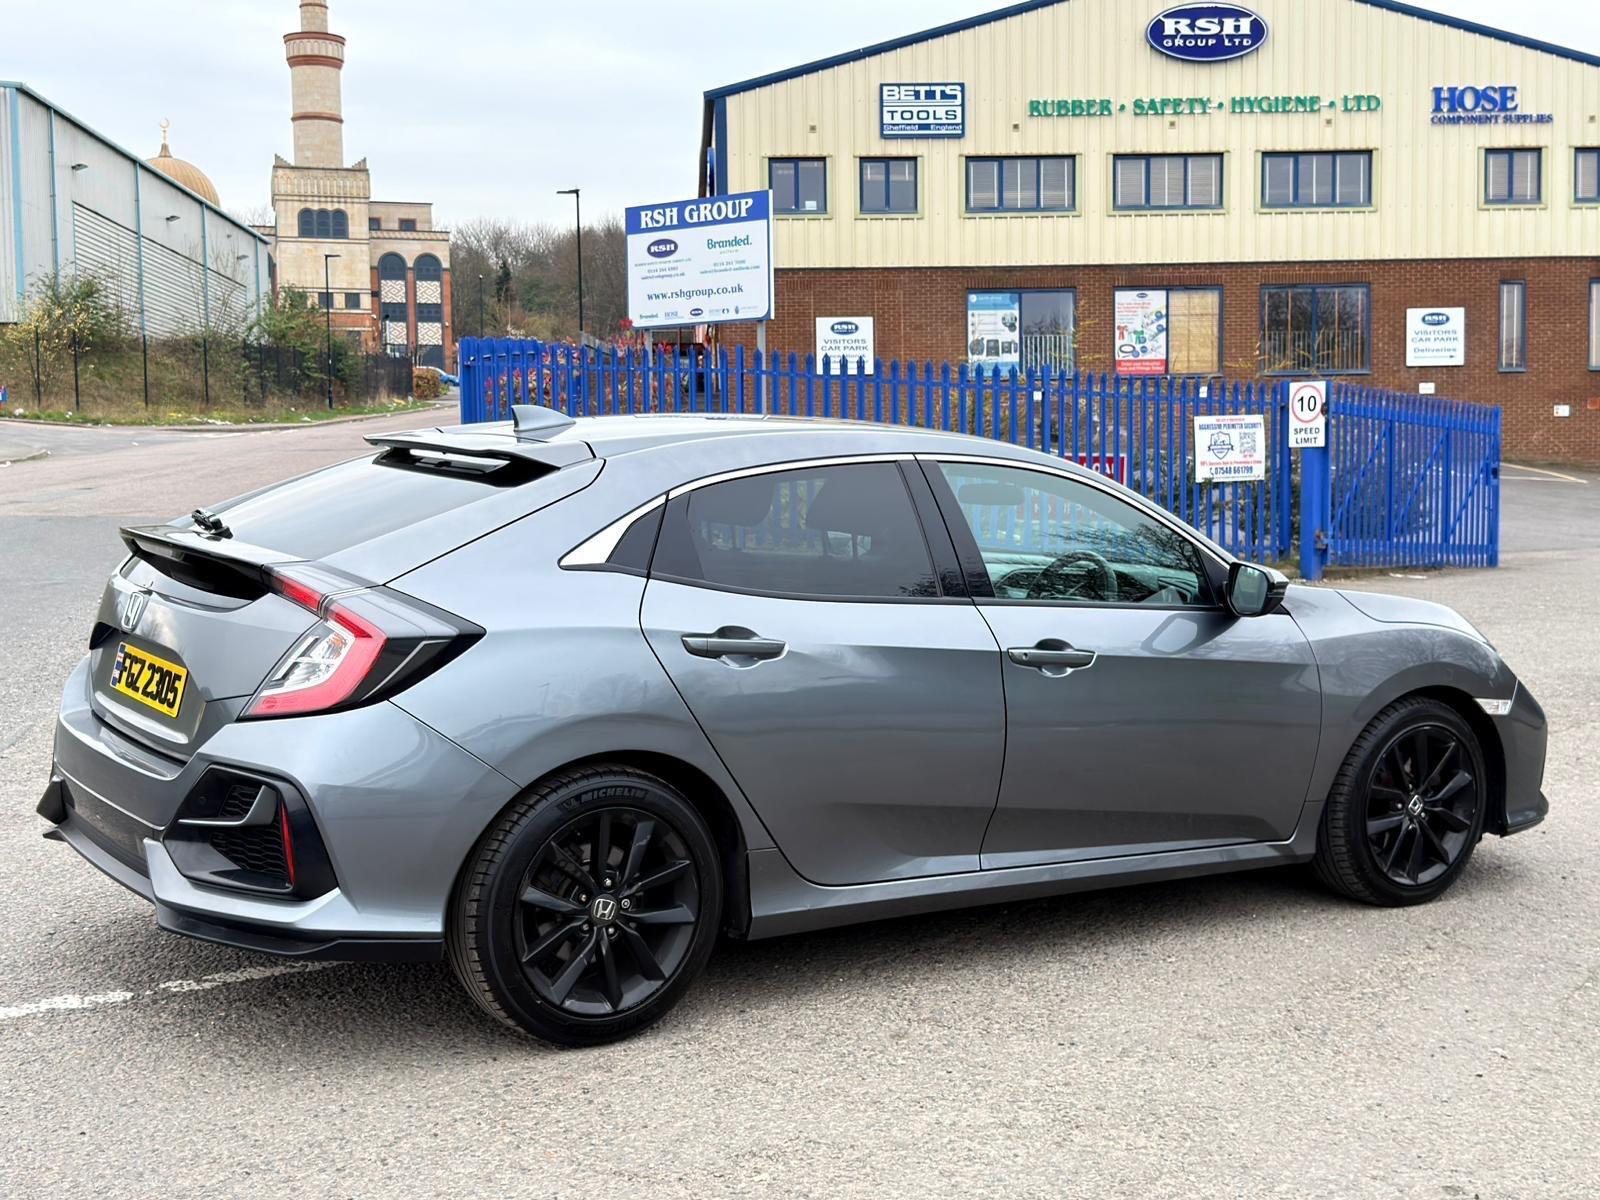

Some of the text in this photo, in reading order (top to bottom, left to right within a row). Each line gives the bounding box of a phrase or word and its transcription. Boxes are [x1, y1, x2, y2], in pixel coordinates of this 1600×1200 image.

[1163, 17, 1251, 35] RSH
[1163, 38, 1252, 47] GROUP LTD
[882, 85, 962, 101] BETTS
[1431, 86, 1518, 113] HOSE
[1028, 94, 1381, 117] RUBBER SAFETY HYGIENE LTD
[886, 109, 958, 121] TOOLS
[1431, 114, 1553, 125] COMPONENT SUPPLIES
[930, 124, 962, 132] England
[640, 198, 753, 229] RSH GROUP
[650, 243, 675, 253] RSH
[647, 283, 743, 301] www.rshgroup.co.uk
[1297, 395, 1317, 413] 10
[1293, 427, 1320, 435] SPEED
[1295, 437, 1318, 445] LIMIT
[1214, 466, 1232, 475] 07548
[118, 651, 182, 709] FGZ 2305
[581, 786, 648, 803] MICHELIN
